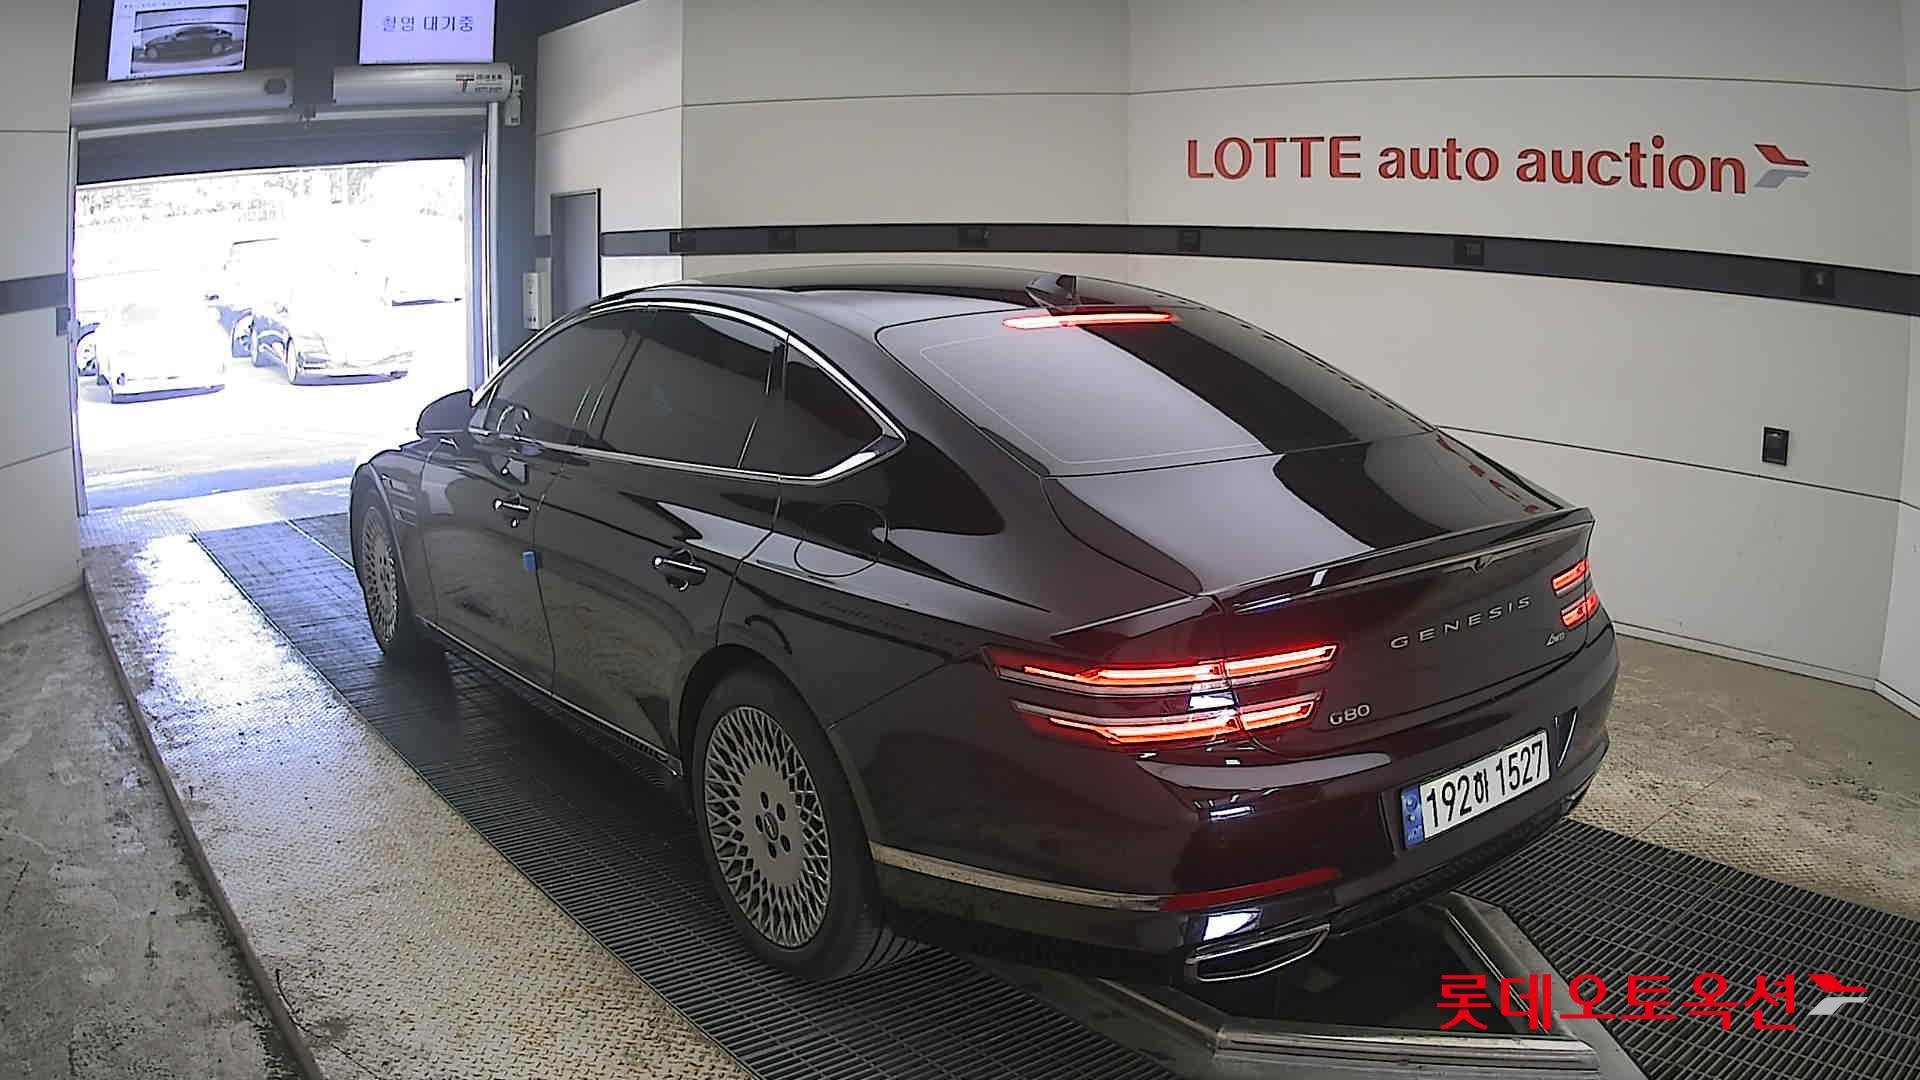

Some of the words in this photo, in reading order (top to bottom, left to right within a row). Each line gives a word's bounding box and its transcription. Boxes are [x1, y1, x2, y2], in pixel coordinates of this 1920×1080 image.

[424, 16, 473, 32] 대기중
[1187, 136, 1361, 179] LOTTE
[1378, 138, 1499, 181] auto
[1516, 135, 1746, 194] auction
[1390, 597, 1530, 648] GENESIS
[1329, 704, 1370, 725] G80
[1426, 768, 1489, 827] 192하
[1496, 740, 1543, 796] 1527
